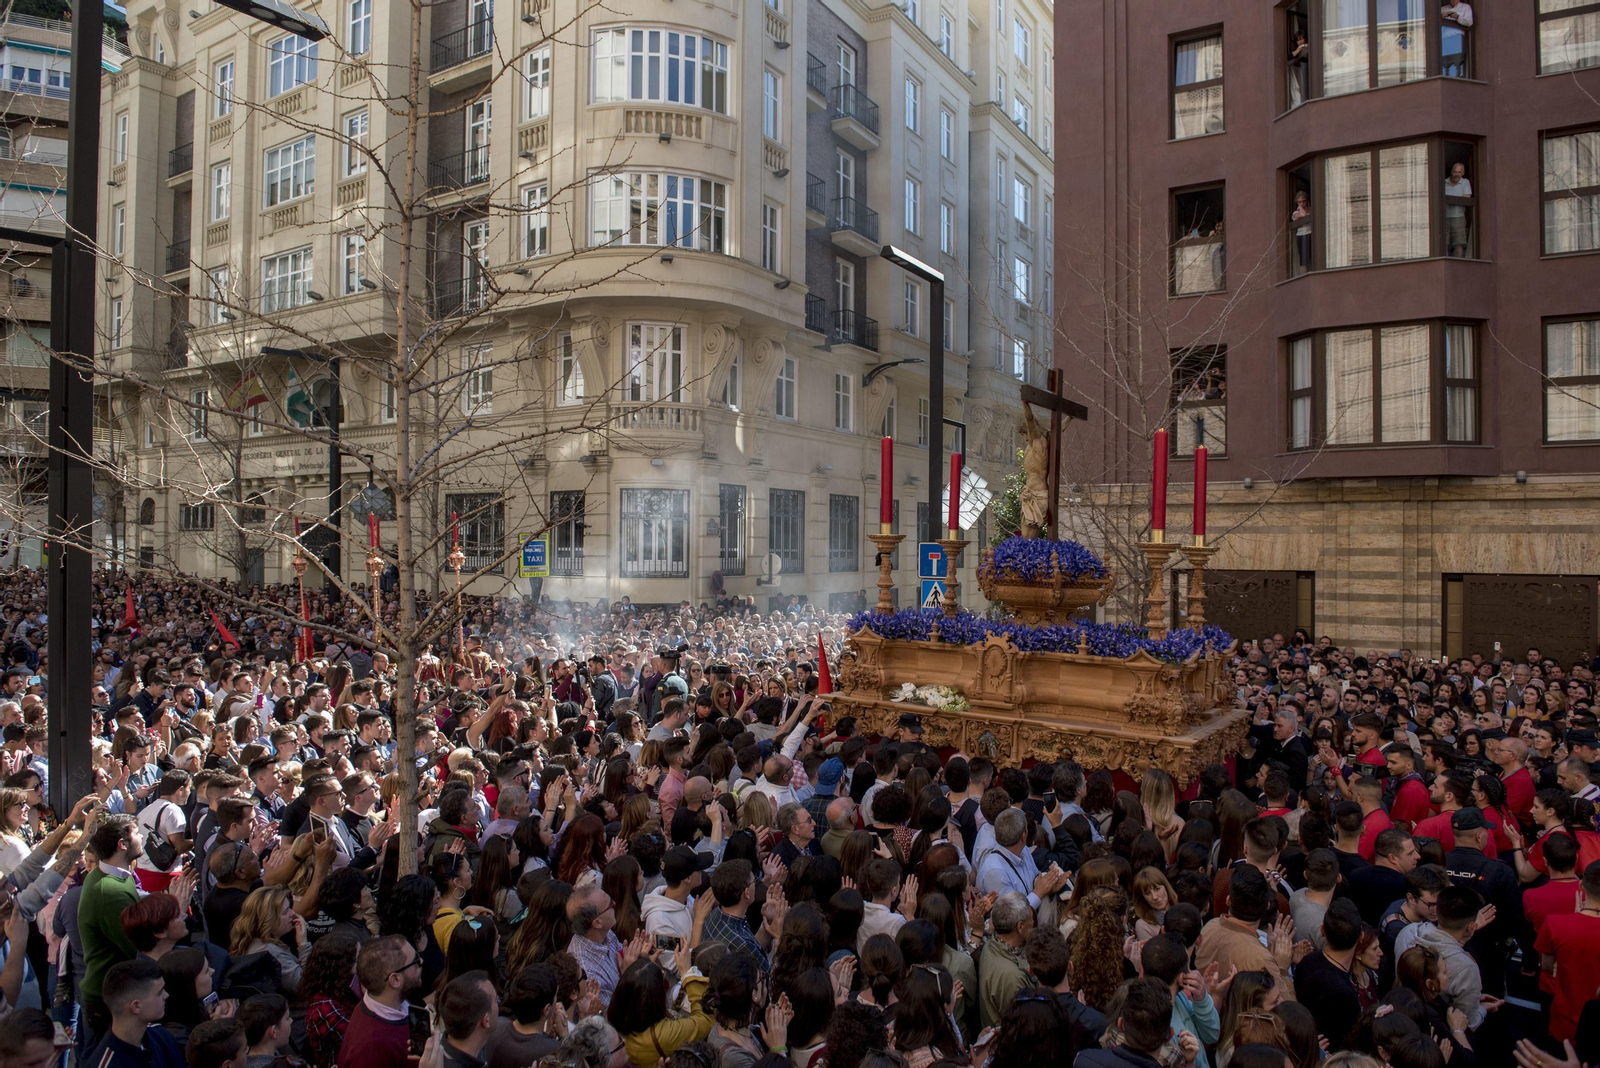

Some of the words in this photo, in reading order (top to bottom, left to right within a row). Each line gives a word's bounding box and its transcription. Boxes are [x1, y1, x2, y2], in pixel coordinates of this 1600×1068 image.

[275, 448, 301, 458] GENERAL
[304, 448, 313, 456] DE
[315, 447, 324, 455] LA
[1523, 582, 1591, 605] spa
[1446, 870, 1476, 878] OLICIA
